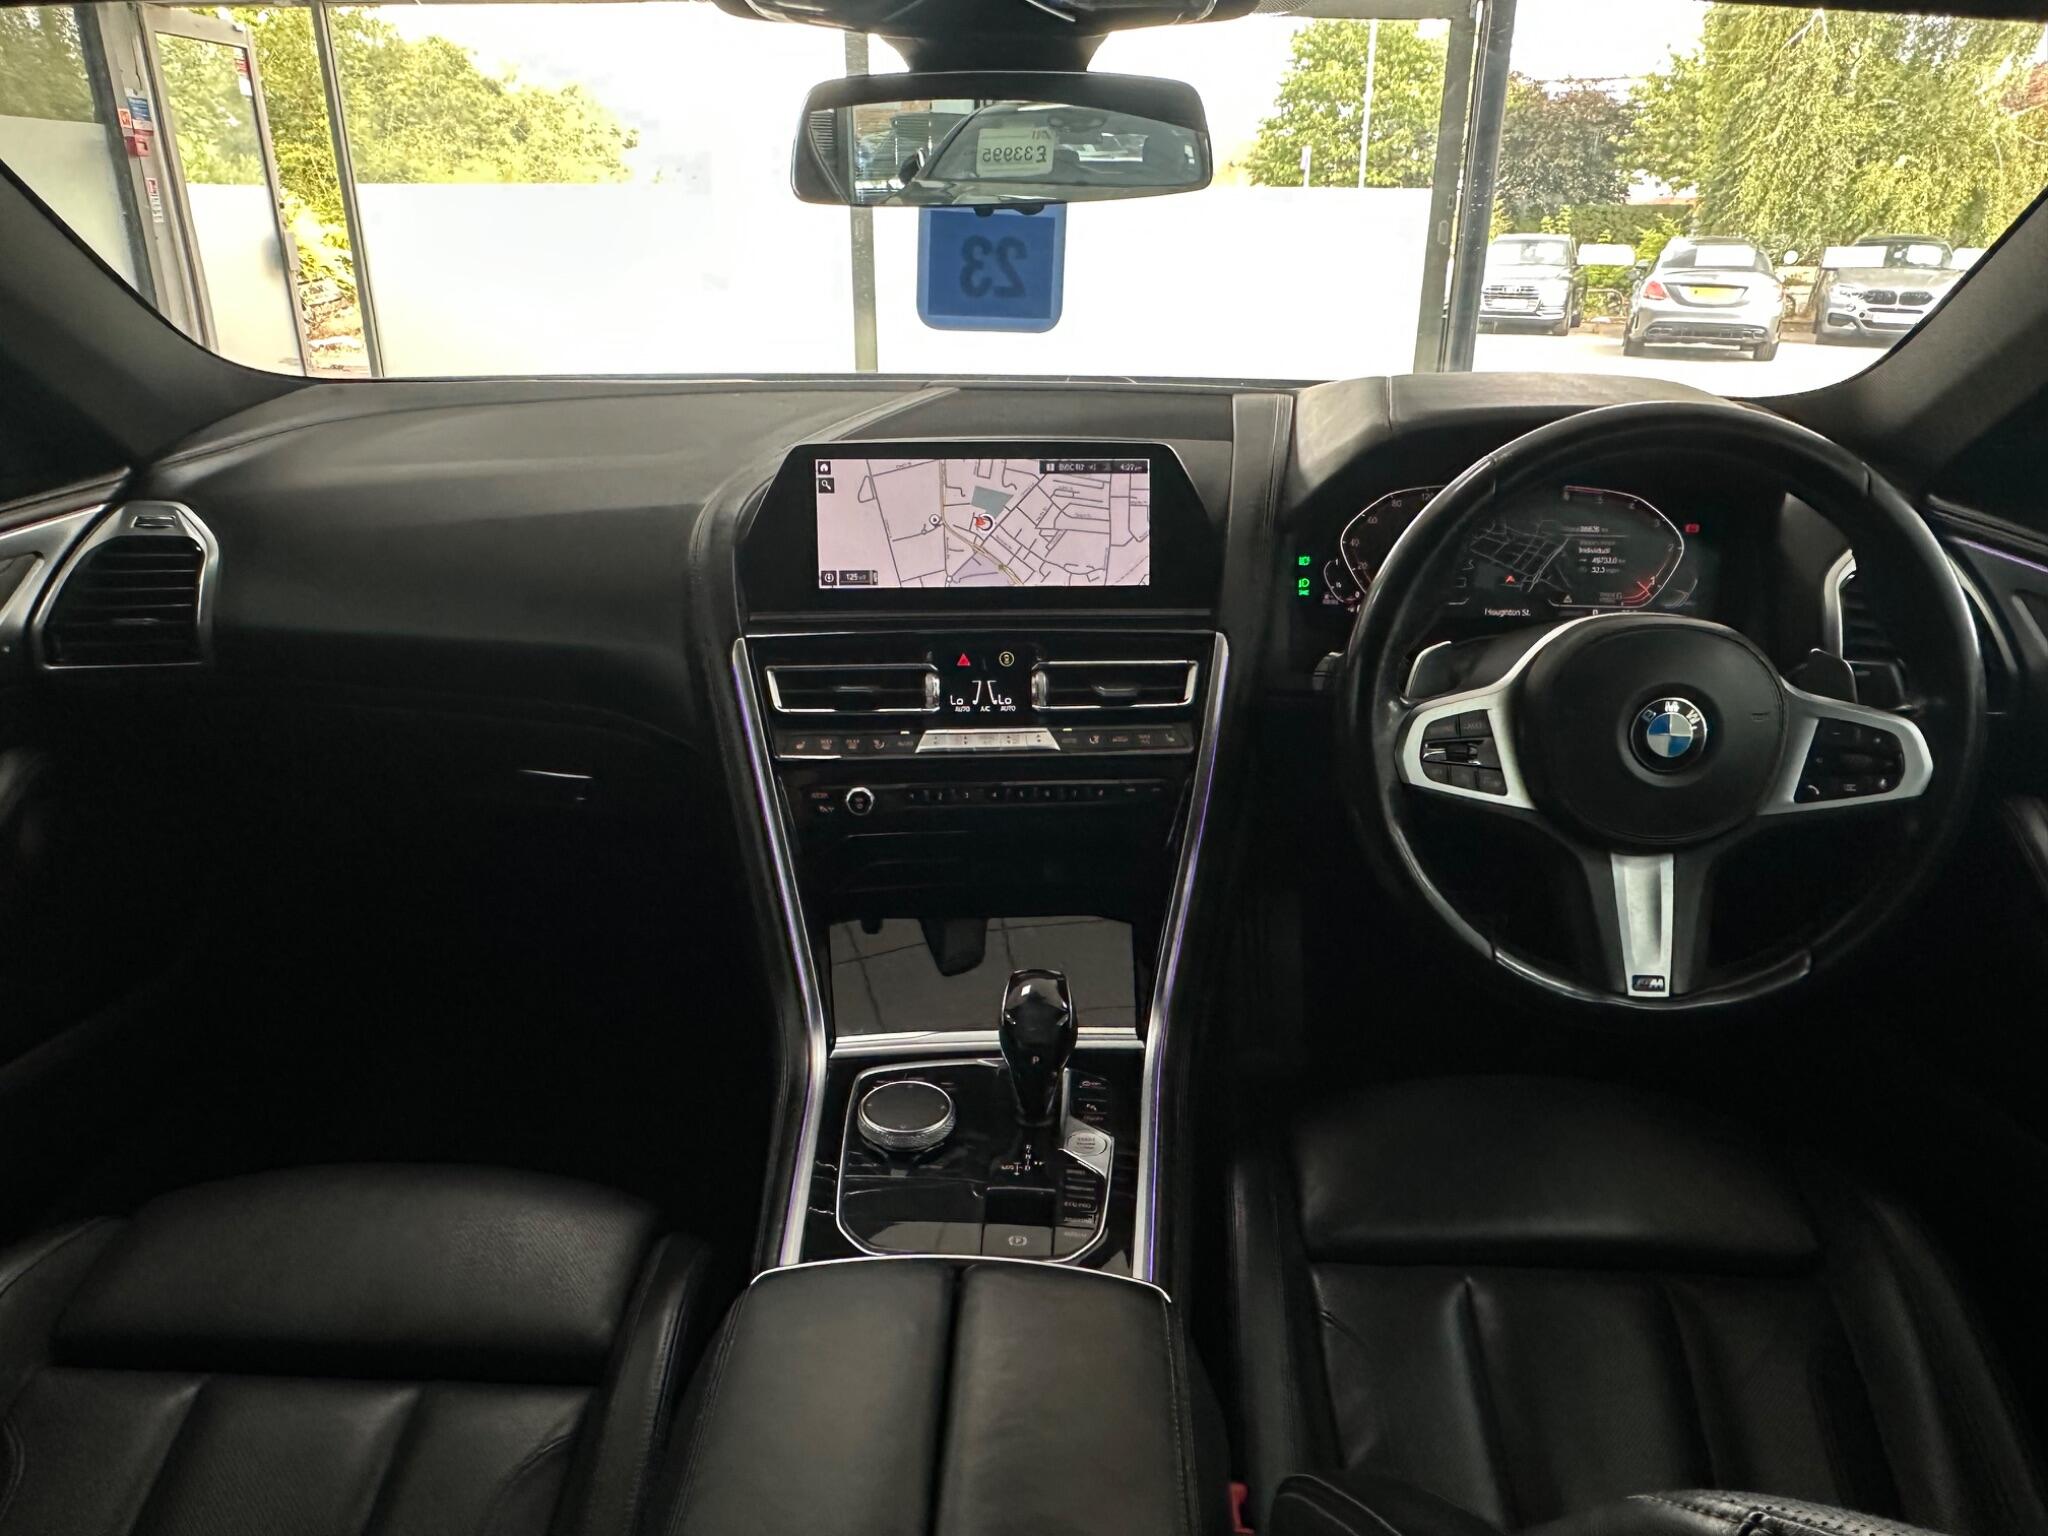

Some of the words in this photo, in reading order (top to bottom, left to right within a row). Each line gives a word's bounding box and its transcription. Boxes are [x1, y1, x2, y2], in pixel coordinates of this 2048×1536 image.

[949, 694, 964, 706] Lo
[997, 693, 1012, 705] Lo
[1641, 700, 1701, 725] BMW
[1032, 1056, 1040, 1065] P
